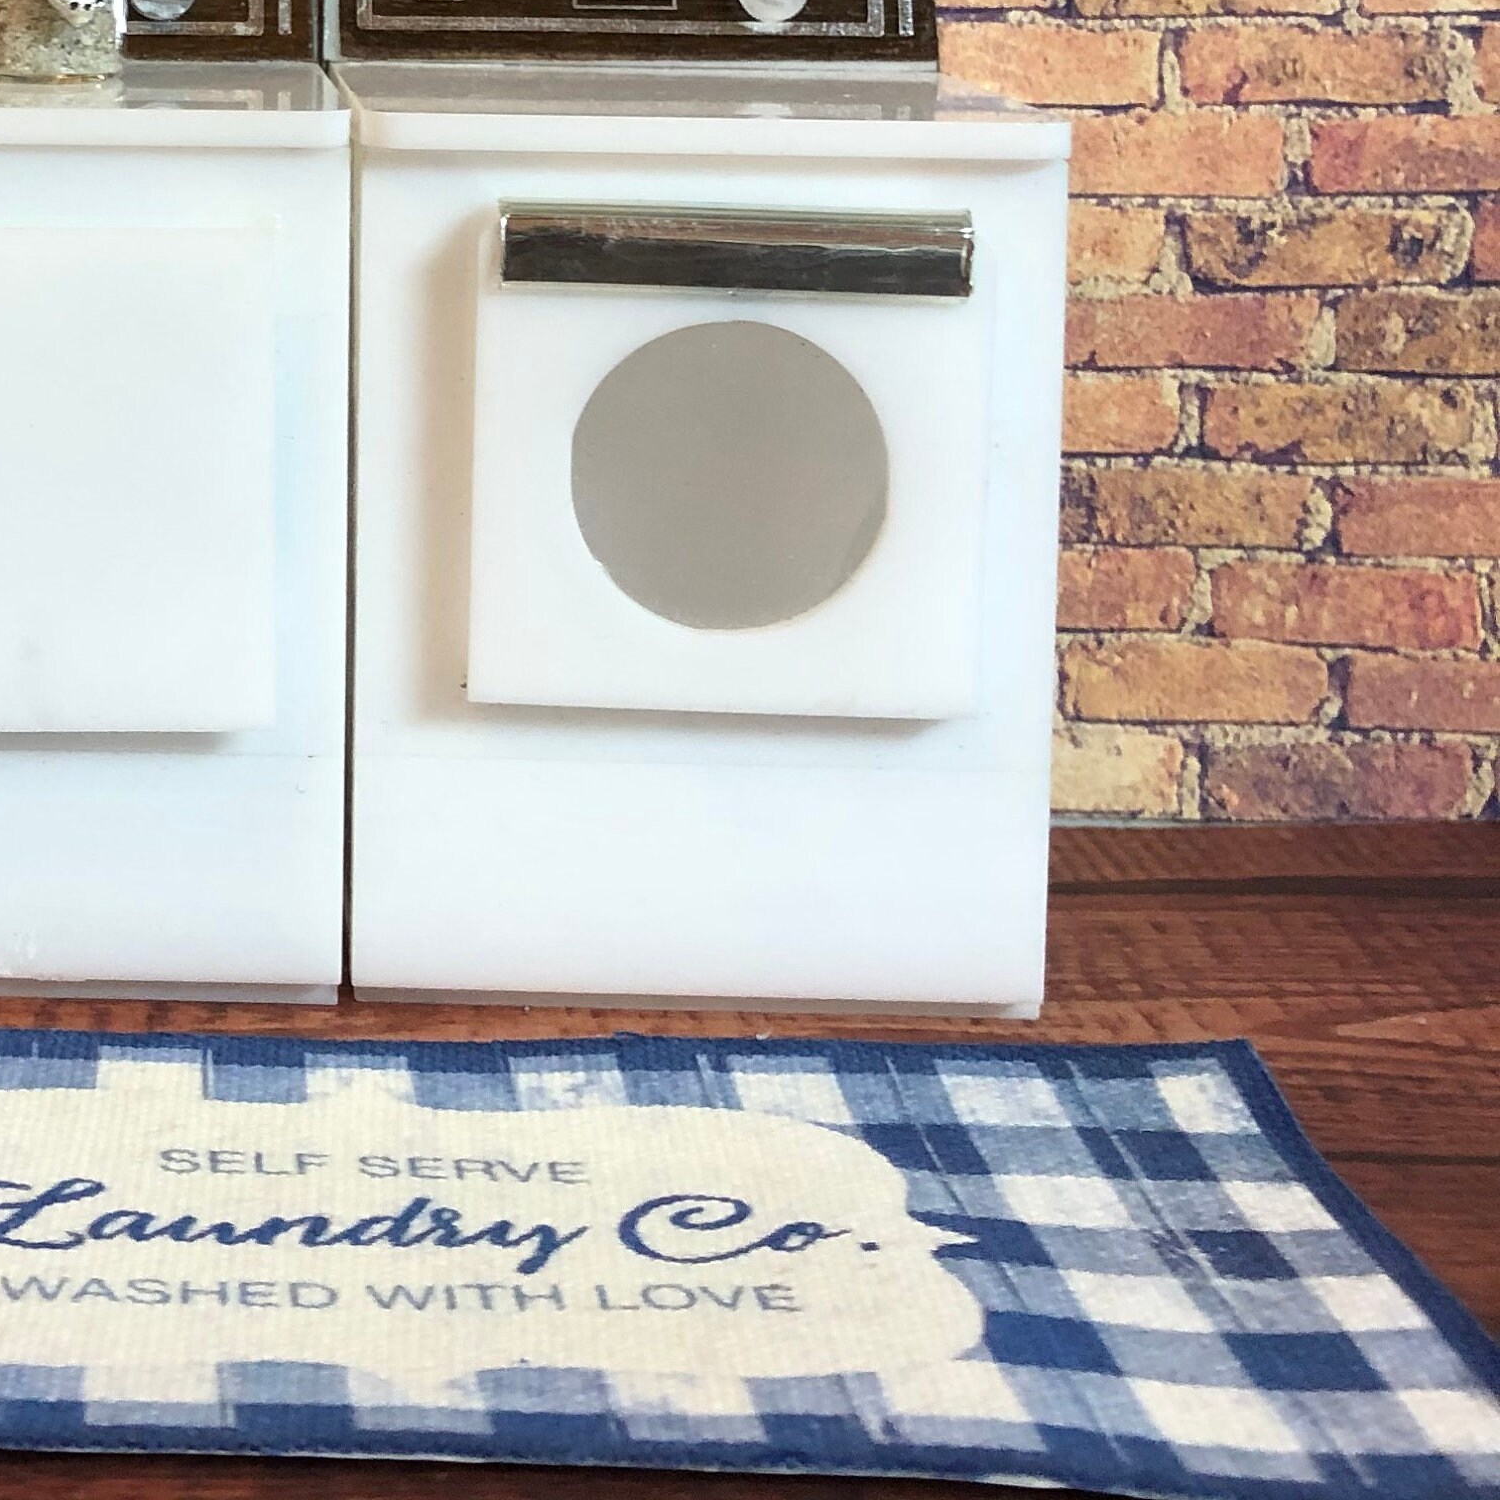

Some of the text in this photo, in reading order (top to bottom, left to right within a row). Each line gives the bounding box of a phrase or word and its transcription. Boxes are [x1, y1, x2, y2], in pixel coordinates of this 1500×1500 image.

[158, 1148, 591, 1186] SELF SERVE
[618, 1194, 881, 1265] Co.
[364, 1281, 567, 1313] WITH
[594, 1282, 803, 1314] LOVE
